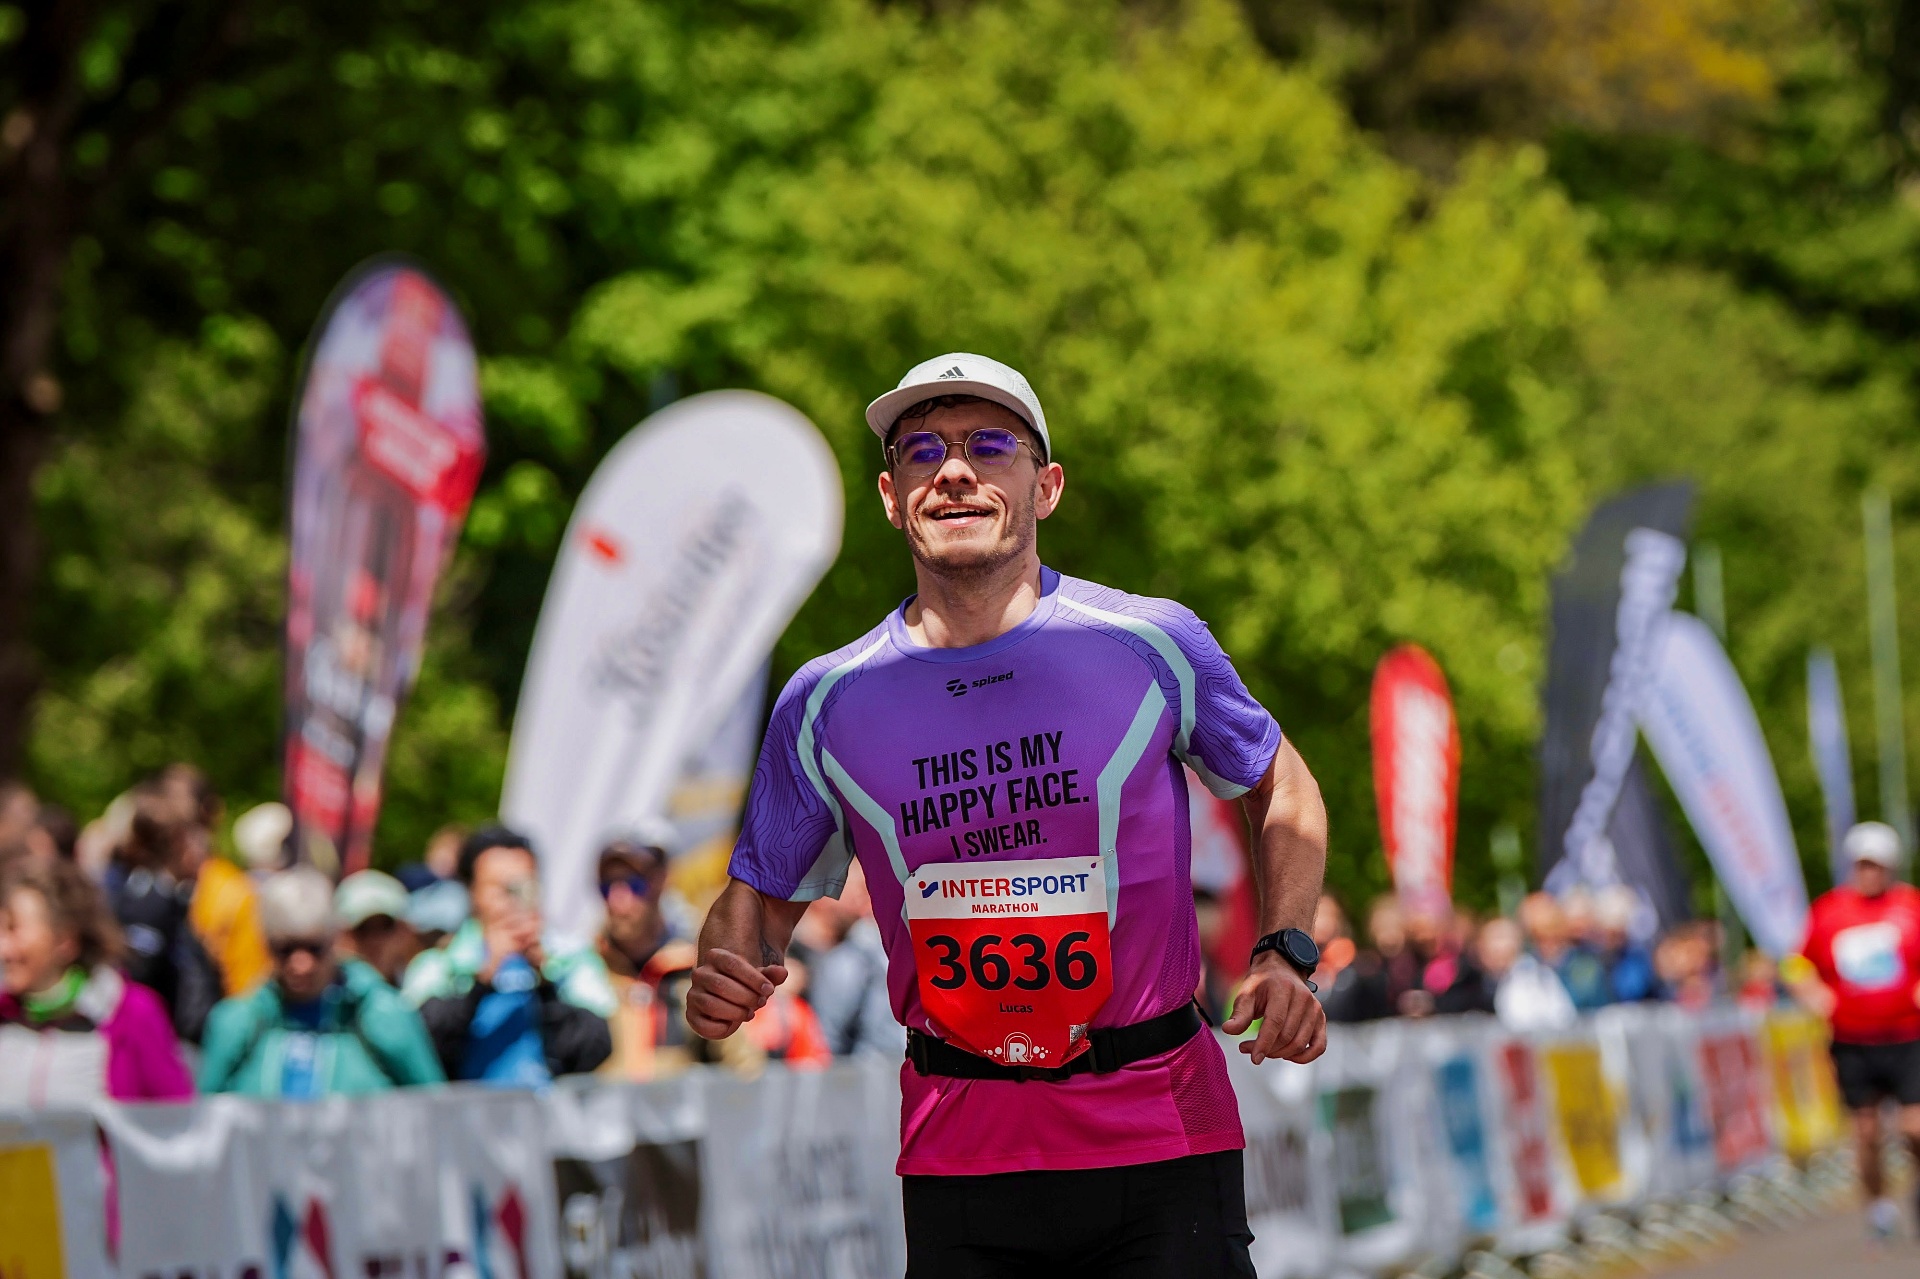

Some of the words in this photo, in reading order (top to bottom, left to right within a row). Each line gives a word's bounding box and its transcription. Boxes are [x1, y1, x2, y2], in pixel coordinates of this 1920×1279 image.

[971, 671, 1014, 688] spized
[912, 748, 978, 790] THIS
[985, 741, 1013, 776] IS
[1019, 731, 1063, 769] MY
[900, 783, 997, 837] HAPPY
[1006, 769, 1090, 814] FACE.
[950, 835, 962, 860] I
[963, 819, 1048, 857] SWEAR.
[941, 874, 1089, 898] INTERSPORT
[971, 902, 1039, 914] MARATHON
[925, 931, 1098, 991] 3636
[1000, 1003, 1034, 1014] Lucas
